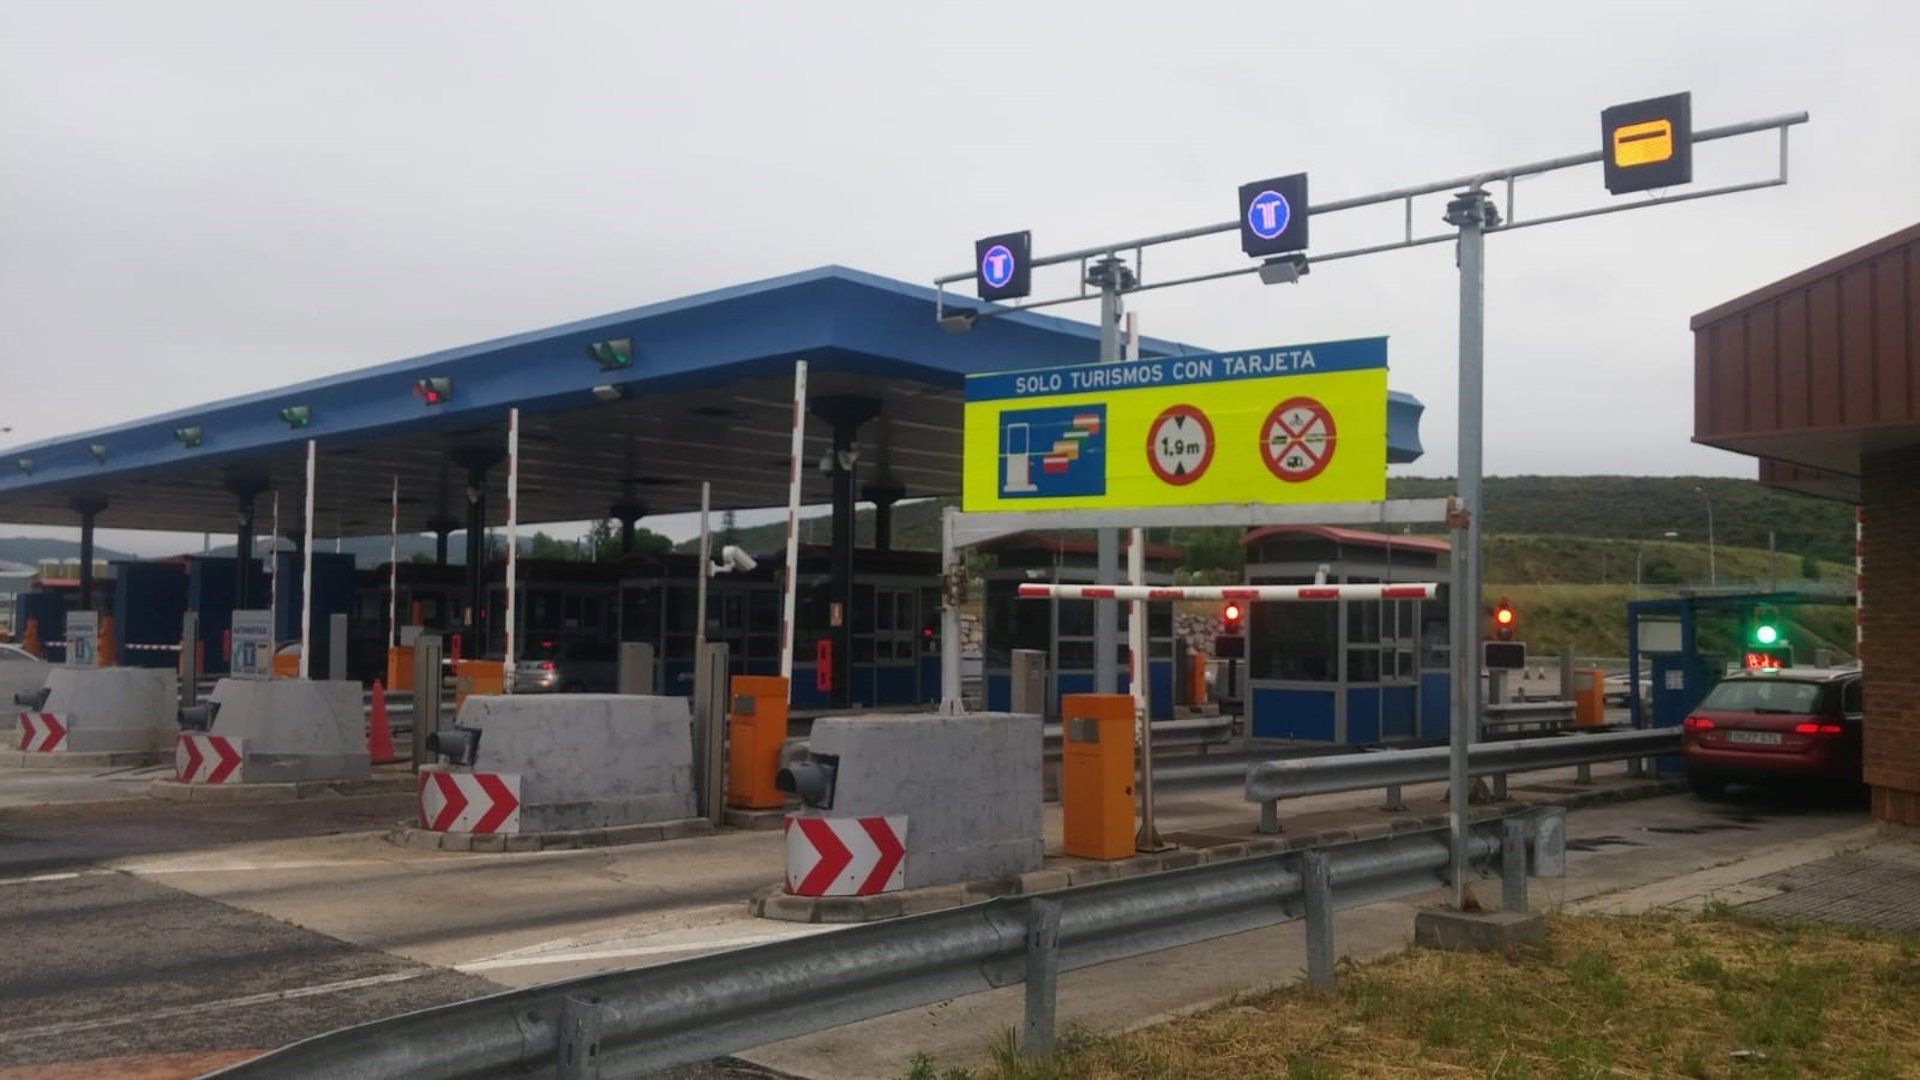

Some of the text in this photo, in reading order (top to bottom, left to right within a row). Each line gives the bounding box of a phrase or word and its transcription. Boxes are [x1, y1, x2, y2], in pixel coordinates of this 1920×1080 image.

[1016, 350, 1316, 394] SOLO TURISMOS CON TARJETA
